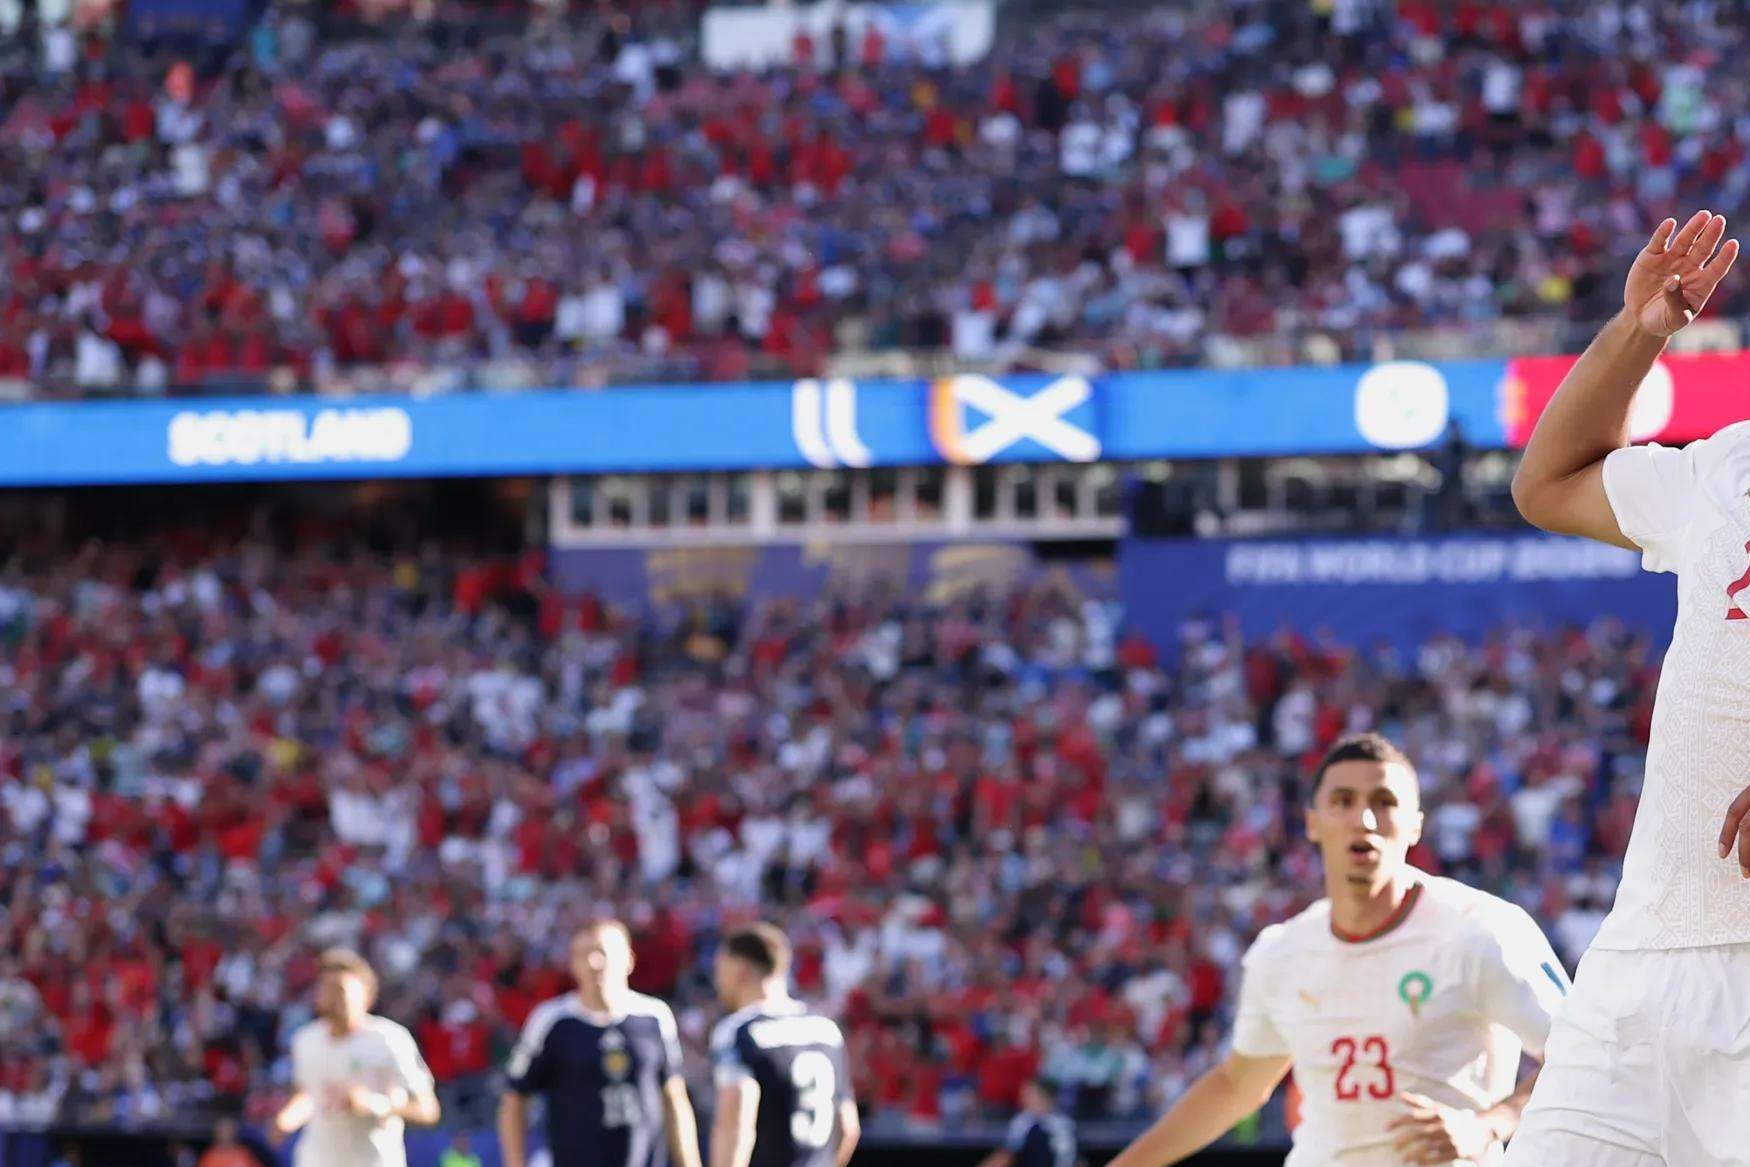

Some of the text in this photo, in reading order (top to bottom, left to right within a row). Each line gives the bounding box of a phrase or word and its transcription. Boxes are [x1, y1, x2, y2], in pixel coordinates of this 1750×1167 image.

[168, 409, 411, 466] SCOTLAND
[789, 1050, 837, 1148] 3
[1331, 1035, 1395, 1102] 23
